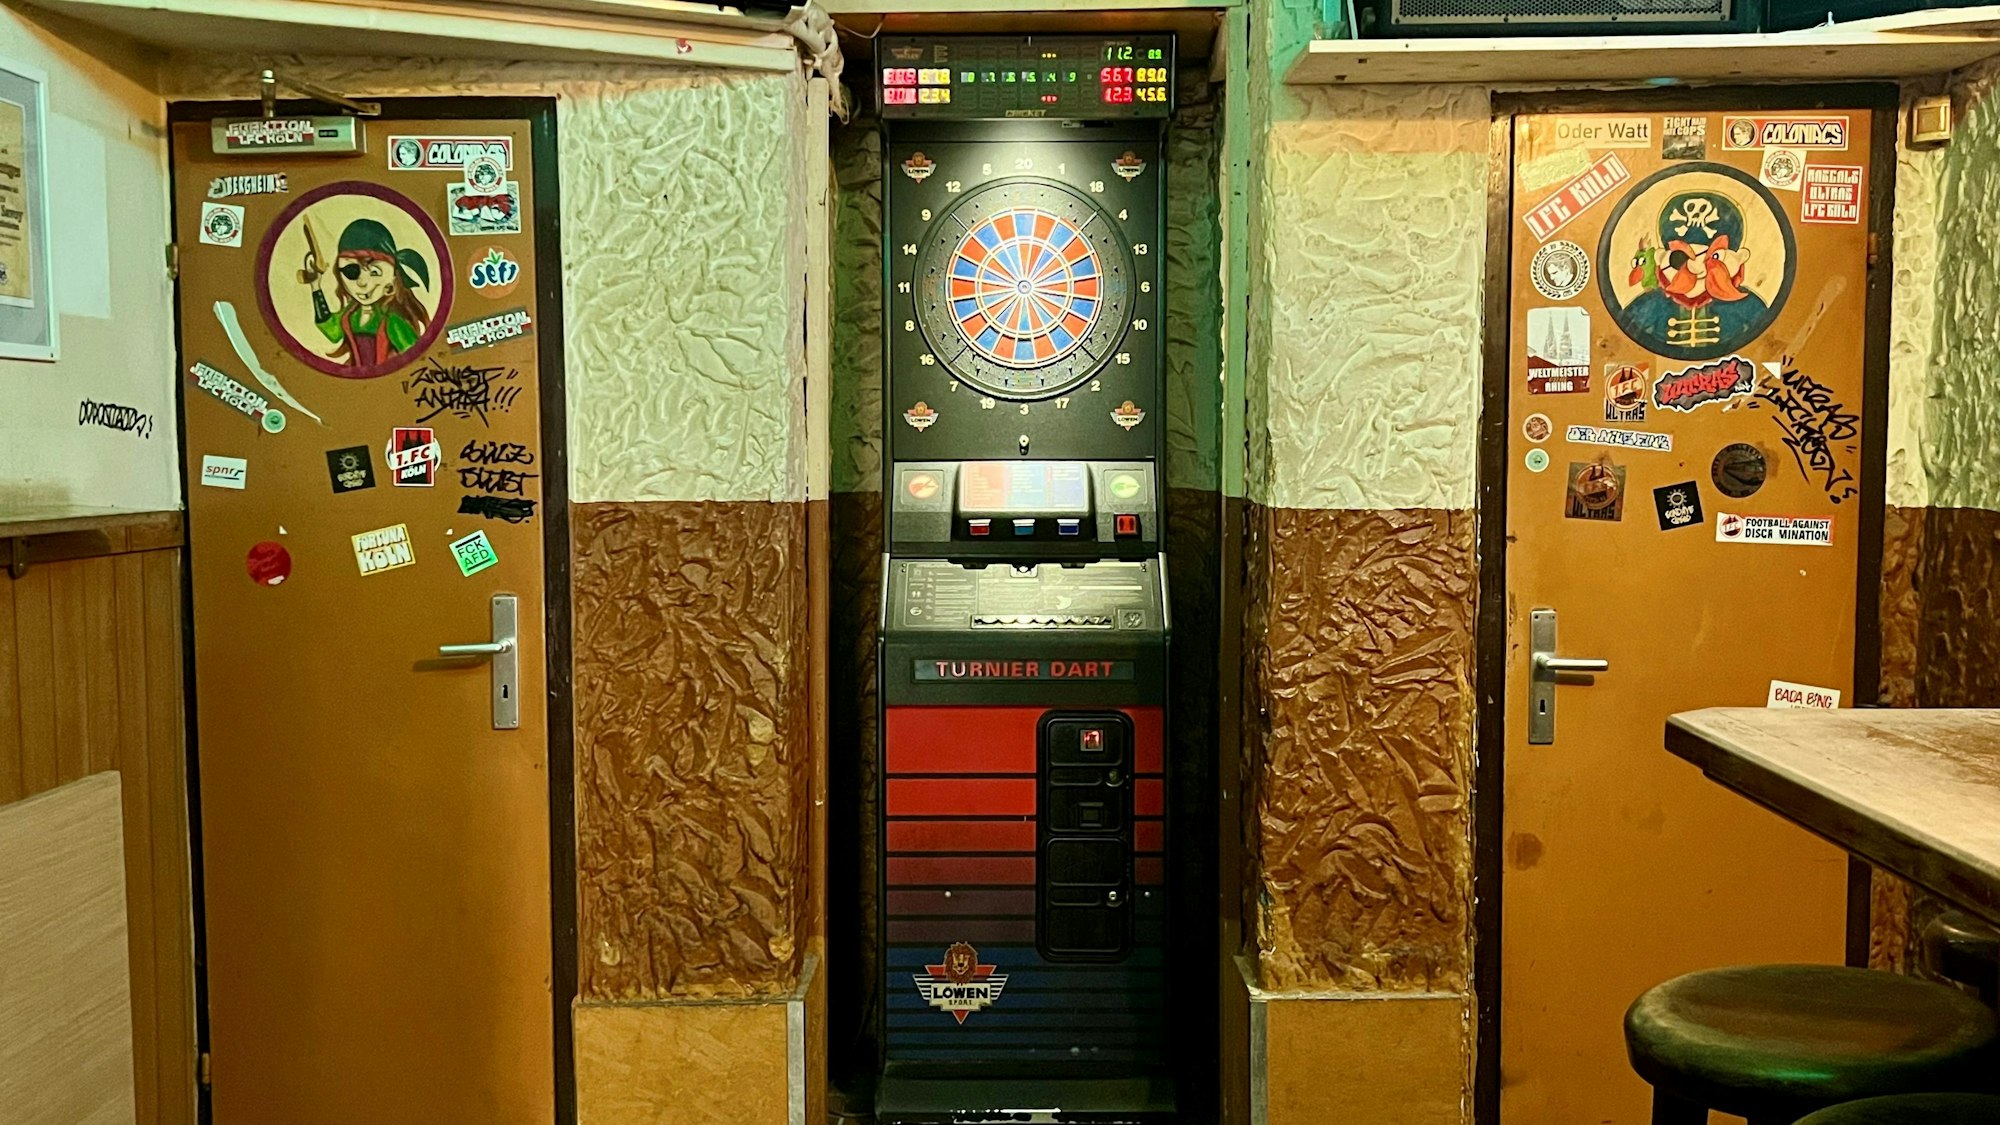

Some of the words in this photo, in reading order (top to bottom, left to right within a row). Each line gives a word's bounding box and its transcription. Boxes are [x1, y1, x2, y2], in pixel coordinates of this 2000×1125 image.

[1558, 123, 1602, 139] Oder
[1608, 123, 1648, 138] Watt
[1677, 125, 1706, 136] COPS
[982, 163, 992, 175] 5
[1015, 158, 1033, 170] 20
[1058, 163, 1066, 175] 1
[946, 181, 961, 193] 12
[1089, 181, 1104, 193] 18
[921, 209, 932, 221] 9
[1118, 209, 1128, 221] 4
[902, 244, 918, 255] 14
[1133, 244, 1148, 255] 13
[898, 282, 911, 293] 11
[1140, 281, 1151, 293] 6
[905, 320, 915, 332] 8
[1133, 319, 1148, 331] 10
[919, 354, 935, 366] 16
[1115, 353, 1130, 365] 15
[1528, 366, 1590, 380] WELTMEISTER
[950, 381, 959, 392] 7
[1091, 380, 1101, 392] 2
[980, 398, 996, 410] 19
[1019, 404, 1029, 415] 3
[1055, 398, 1069, 409] 17
[401, 463, 427, 480] KÖLN
[1745, 518, 1791, 528] FOOTBALL
[1792, 520, 1830, 529] AGAINST
[457, 540, 485, 559] FCK
[464, 549, 489, 567] AFD
[936, 661, 1039, 677] TURNIER
[1050, 661, 1114, 677] DART
[1774, 687, 1803, 704] BADA
